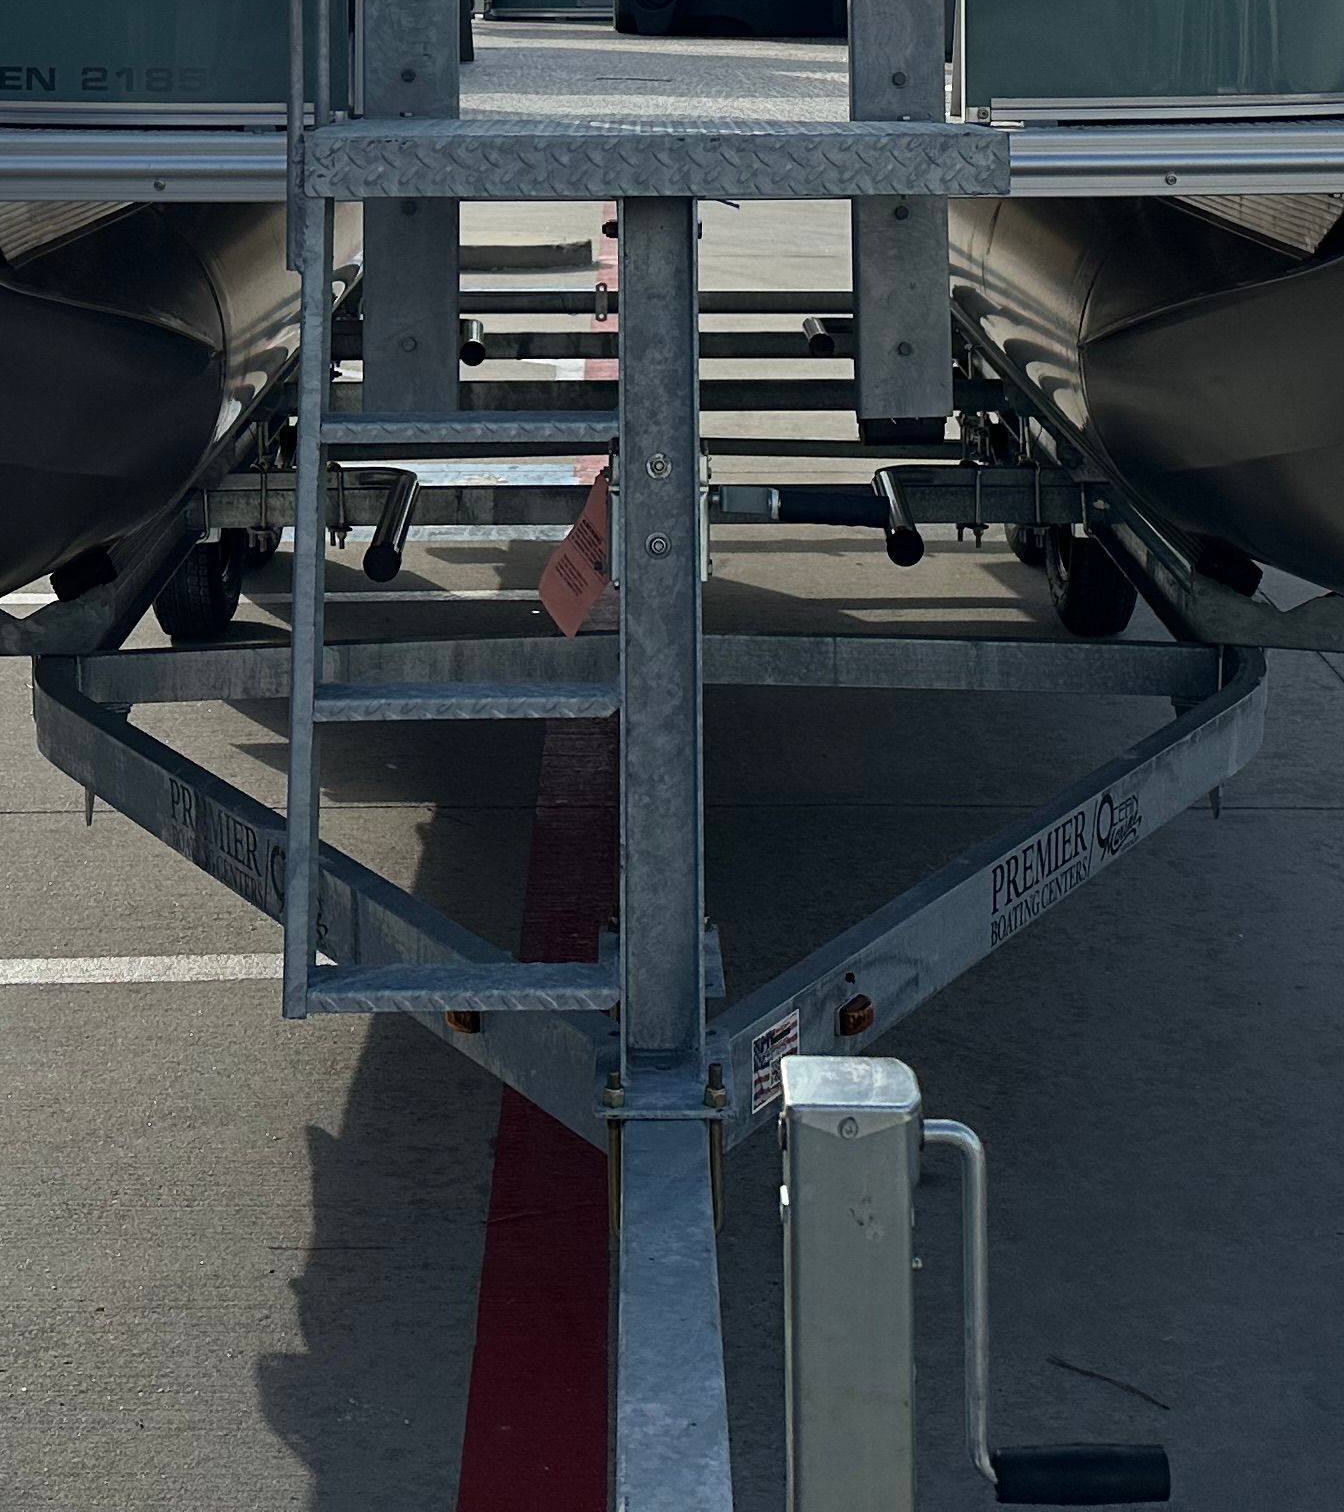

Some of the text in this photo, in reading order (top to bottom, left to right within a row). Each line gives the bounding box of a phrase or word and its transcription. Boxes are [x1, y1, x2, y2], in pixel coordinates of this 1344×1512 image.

[81, 66, 208, 93] 2185
[990, 856, 1088, 948] BOATING CENTERS
[991, 811, 1088, 916] PREMIER
